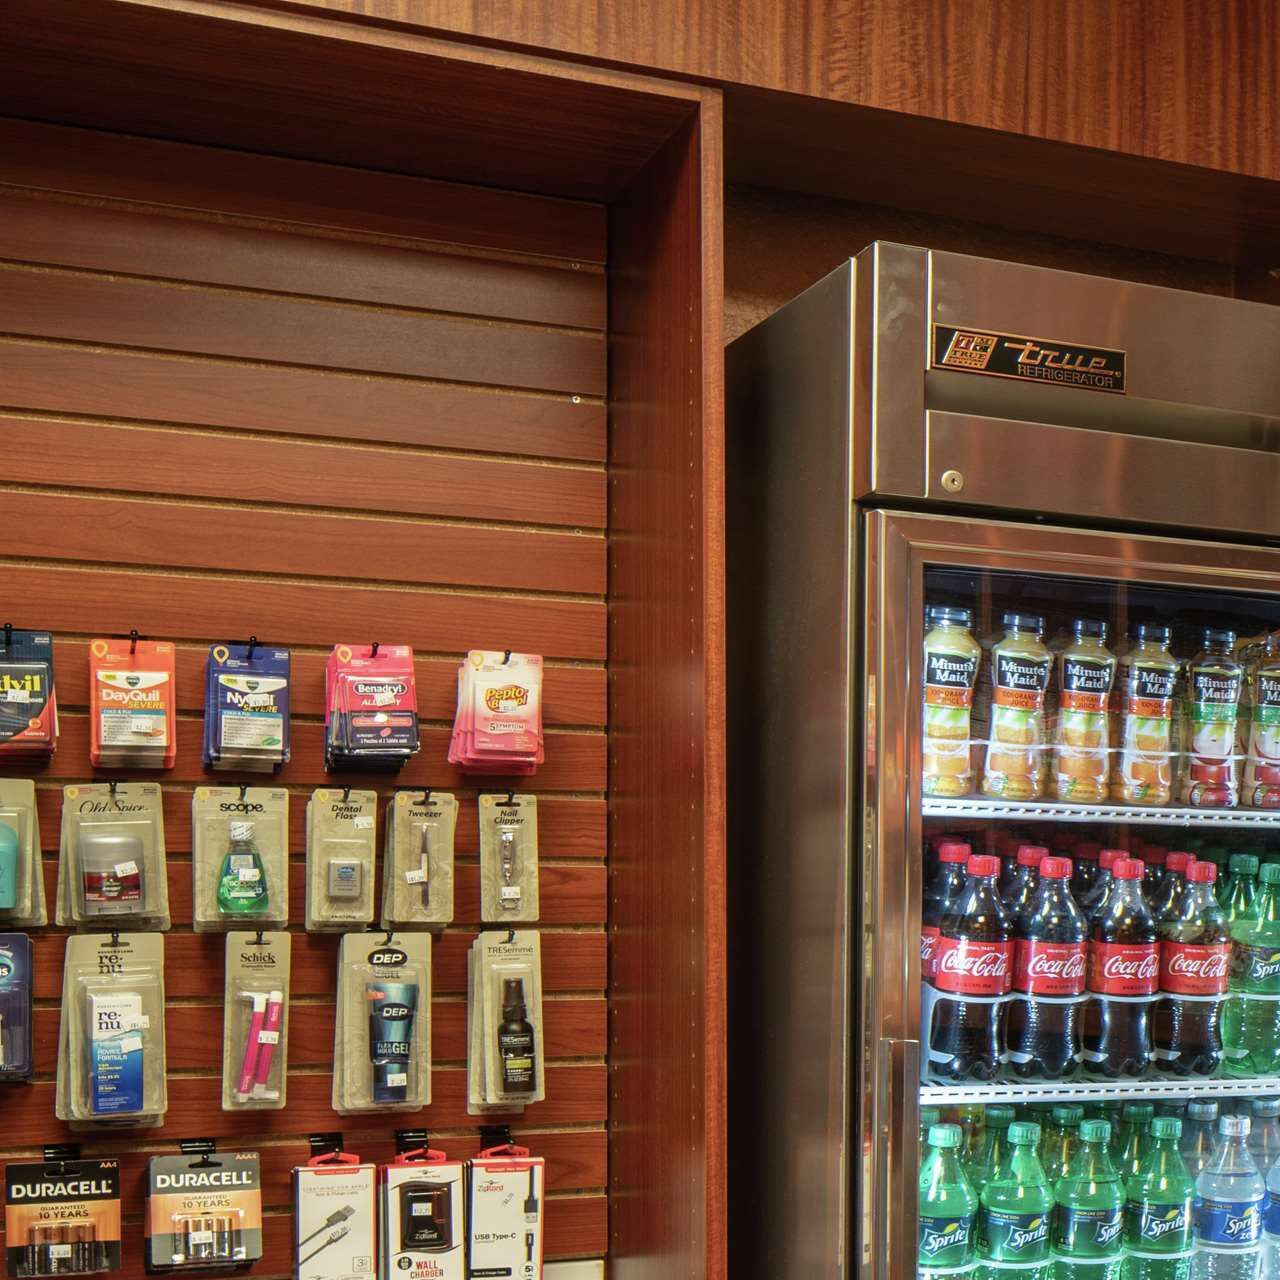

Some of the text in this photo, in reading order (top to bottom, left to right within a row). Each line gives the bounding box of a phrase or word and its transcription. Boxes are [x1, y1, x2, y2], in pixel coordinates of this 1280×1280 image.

[1018, 364, 1113, 387] REFRIGERATOR
[1001, 661, 1046, 675] Minute
[1005, 673, 1037, 686] Maid
[102, 689, 160, 704] DayQuil
[220, 802, 264, 814] scope
[331, 805, 362, 813] Dental
[408, 810, 442, 818] Tweezer
[494, 817, 524, 825] Clipper
[241, 952, 275, 963] Schick
[373, 954, 403, 963] DEP
[383, 1007, 408, 1017] DEP
[156, 1171, 252, 1188] DURACELL
[12, 1180, 112, 1198] DURACELL
[196, 1199, 231, 1207] YEARS
[39, 1210, 88, 1219] 10 YEARS
[925, 1229, 966, 1250] Sprite
[415, 1260, 437, 1269] WALL
[410, 1269, 444, 1279] CHARGER
